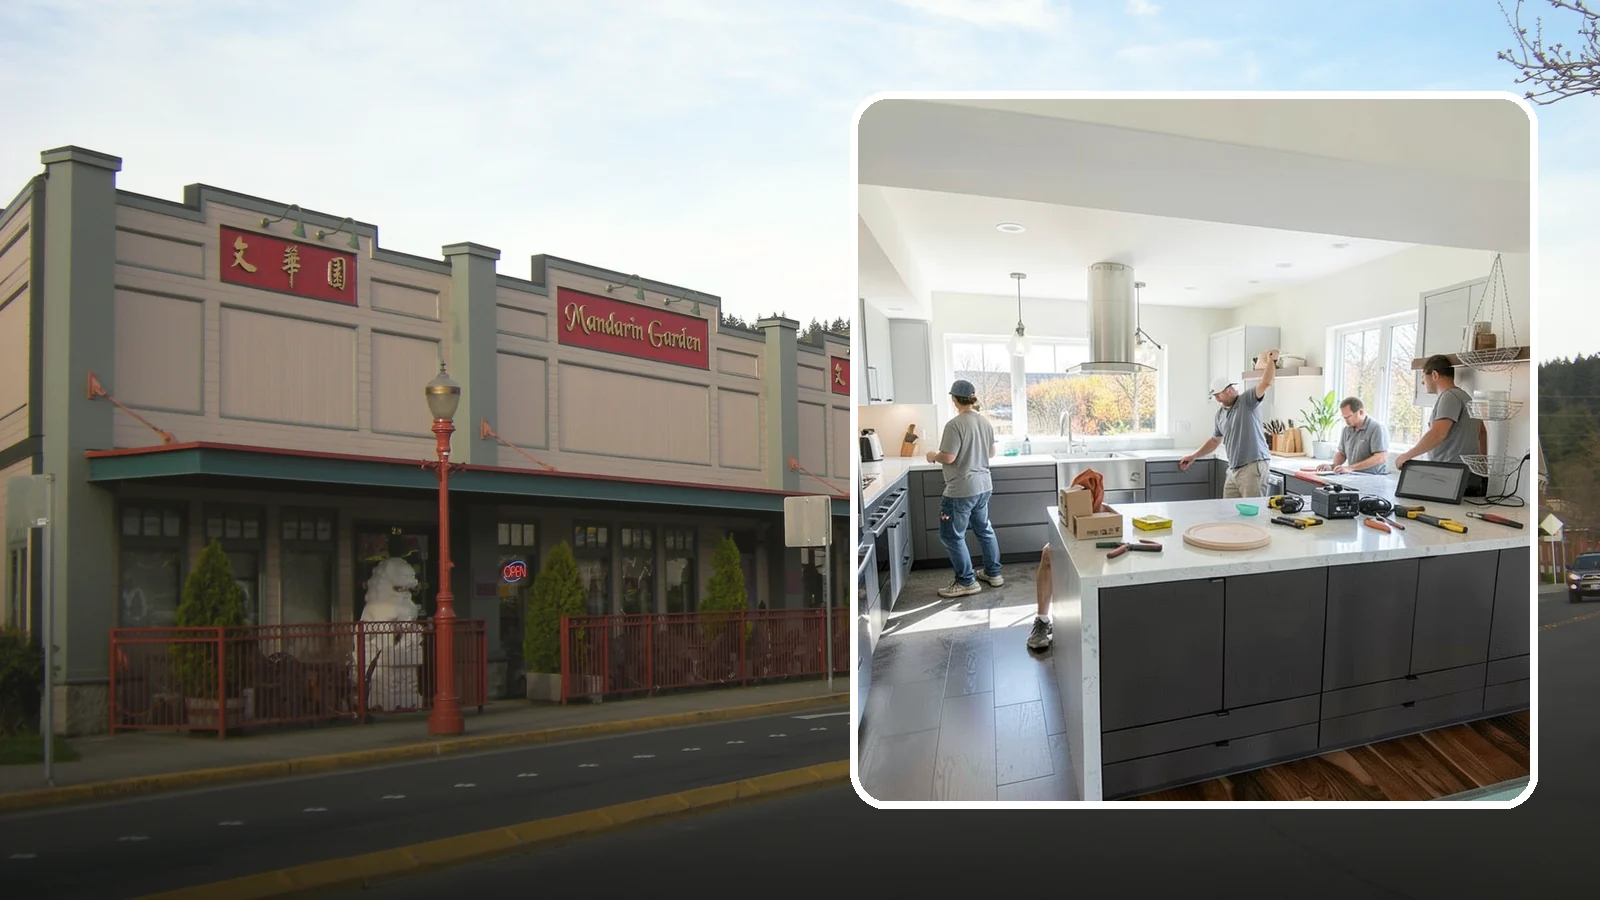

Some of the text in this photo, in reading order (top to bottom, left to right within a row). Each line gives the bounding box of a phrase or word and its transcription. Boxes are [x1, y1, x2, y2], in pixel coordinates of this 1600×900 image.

[230, 235, 346, 291] 文華園
[564, 302, 701, 352] Mandarin Garden
[503, 565, 527, 578] OPEN
